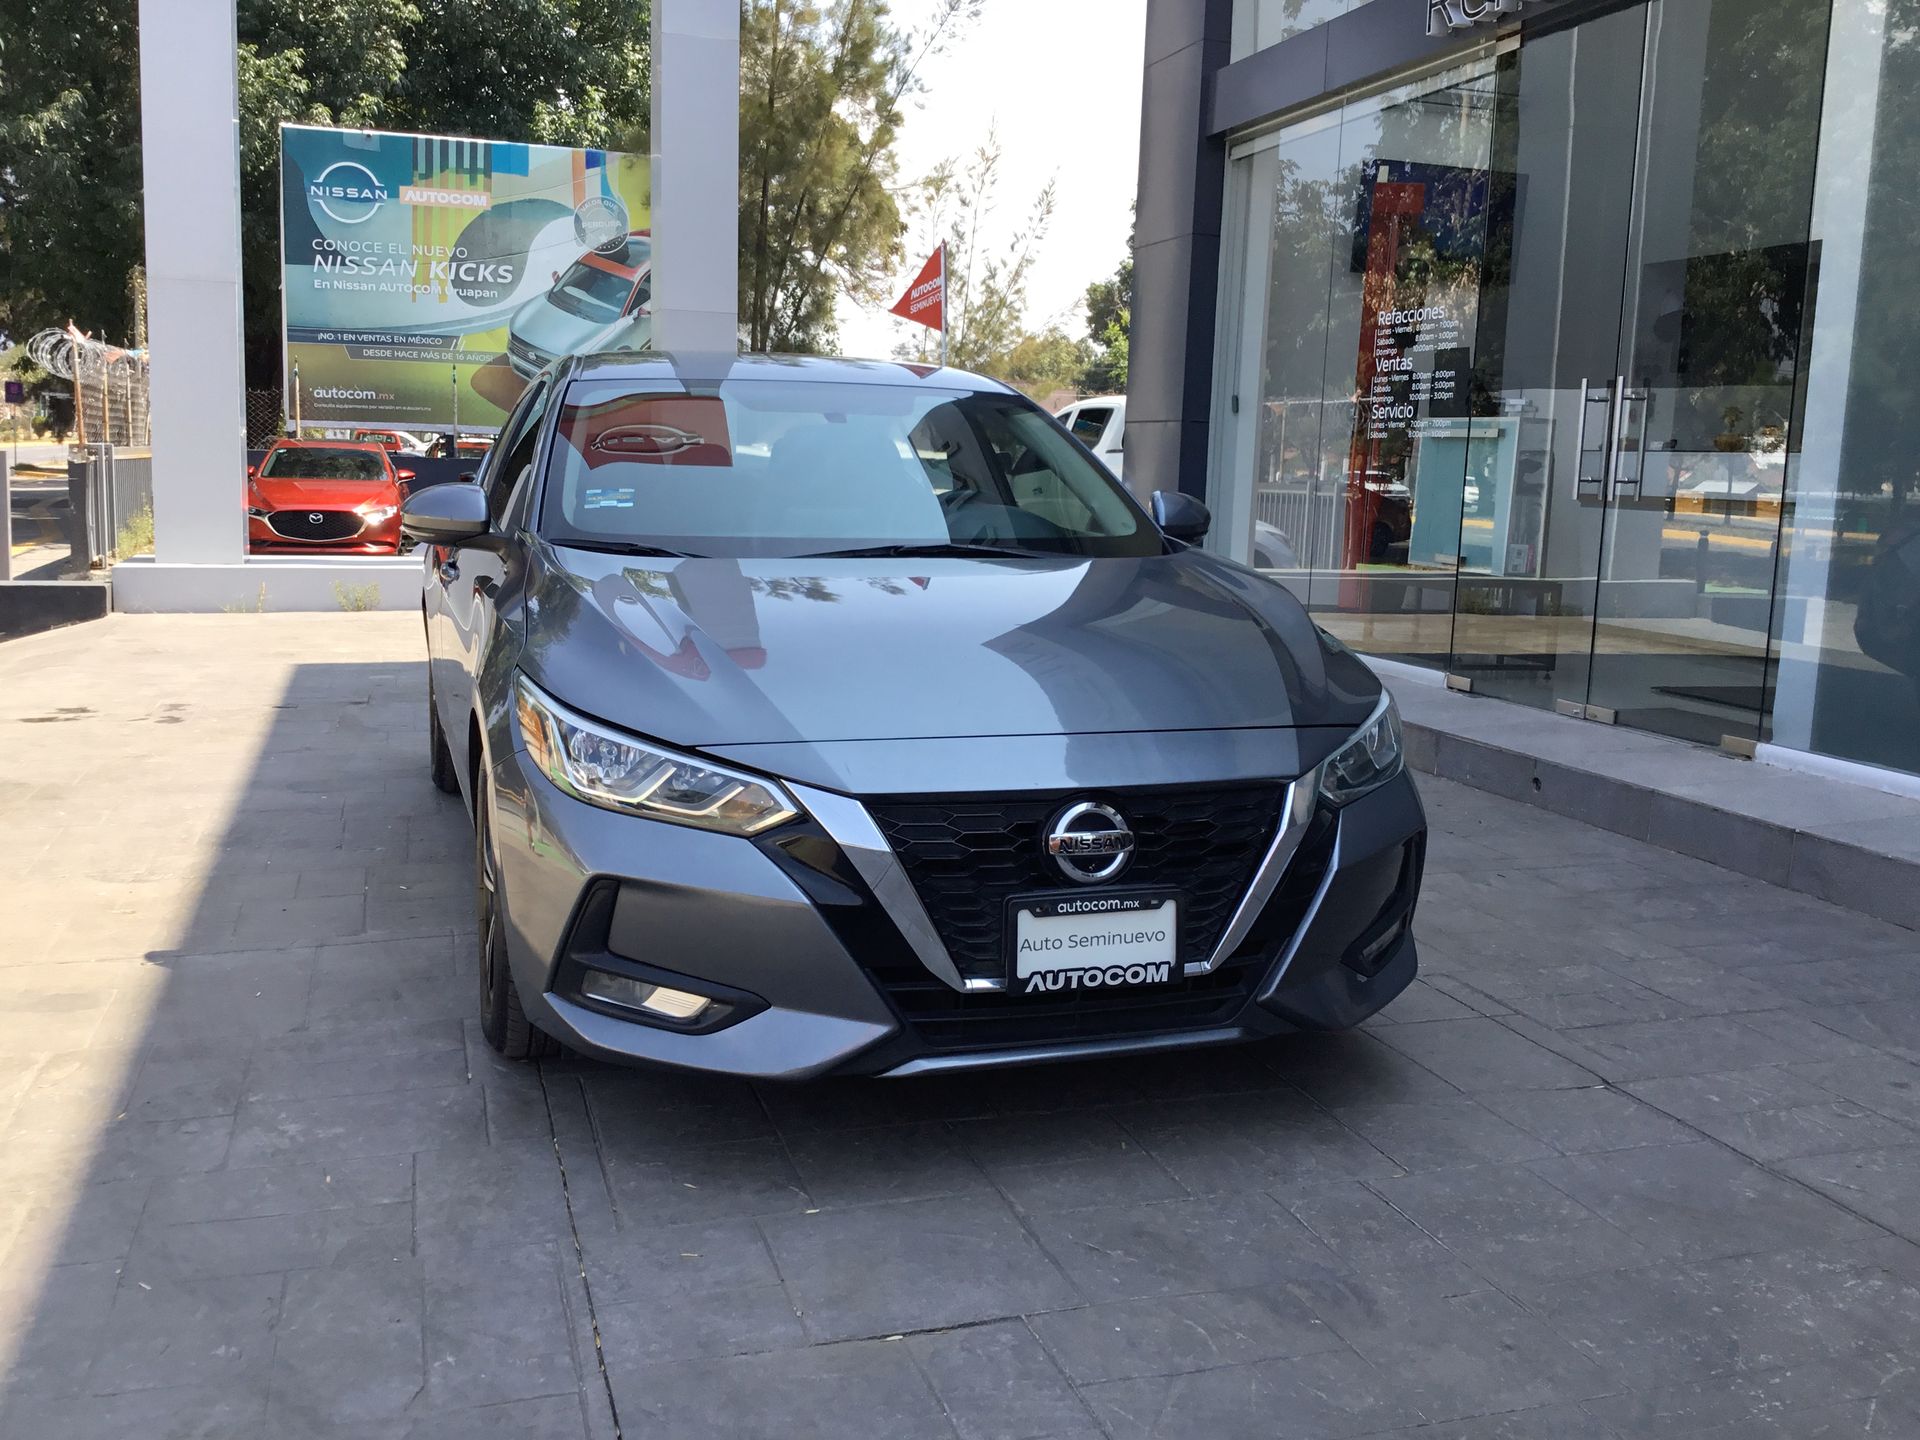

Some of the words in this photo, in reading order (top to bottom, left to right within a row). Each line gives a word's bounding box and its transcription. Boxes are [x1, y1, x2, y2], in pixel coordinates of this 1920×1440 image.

[310, 185, 387, 200] NISSAN
[405, 190, 487, 206] AUTOCOM
[312, 239, 383, 253] CONOCE
[389, 243, 407, 255] EL
[412, 244, 468, 259] NUEVO
[313, 254, 418, 278] NISSAN
[429, 260, 513, 284] KICKS
[314, 279, 330, 289] En
[334, 280, 376, 292] Nissan
[379, 282, 441, 295] AUTOCOM
[1377, 305, 1445, 326] Refacciones
[1377, 328, 1391, 336] Lunes
[1395, 325, 1412, 334] Viernes
[337, 333, 342, 341] 1
[343, 334, 356, 342] EN
[356, 334, 392, 343] VENTAS
[393, 335, 406, 344] EN
[407, 334, 443, 345] MÉXICO
[1377, 337, 1395, 346] Sábado
[363, 349, 392, 358] DESDE
[394, 350, 418, 359] HACE
[420, 349, 440, 360] MÁS
[441, 352, 453, 360] DE
[455, 353, 465, 361] 16
[1376, 347, 1398, 357] Domingo
[1375, 357, 1413, 372] Ventas
[1374, 375, 1388, 383] Lunes
[1391, 373, 1409, 382] Viernes
[314, 386, 395, 401] autocom.mx
[1373, 385, 1391, 393] Sábado
[1372, 394, 1394, 404] Domingo
[1372, 403, 1414, 419] Servicio
[1388, 419, 1406, 428] Viernes
[1370, 430, 1388, 438] Sábado
[1059, 836, 1127, 853] NISSAN
[1057, 899, 1140, 913] autocom.mx
[1019, 938, 1063, 953] Auto
[1067, 930, 1166, 949] Seminuevo
[1025, 963, 1170, 993] AUTOCOM
